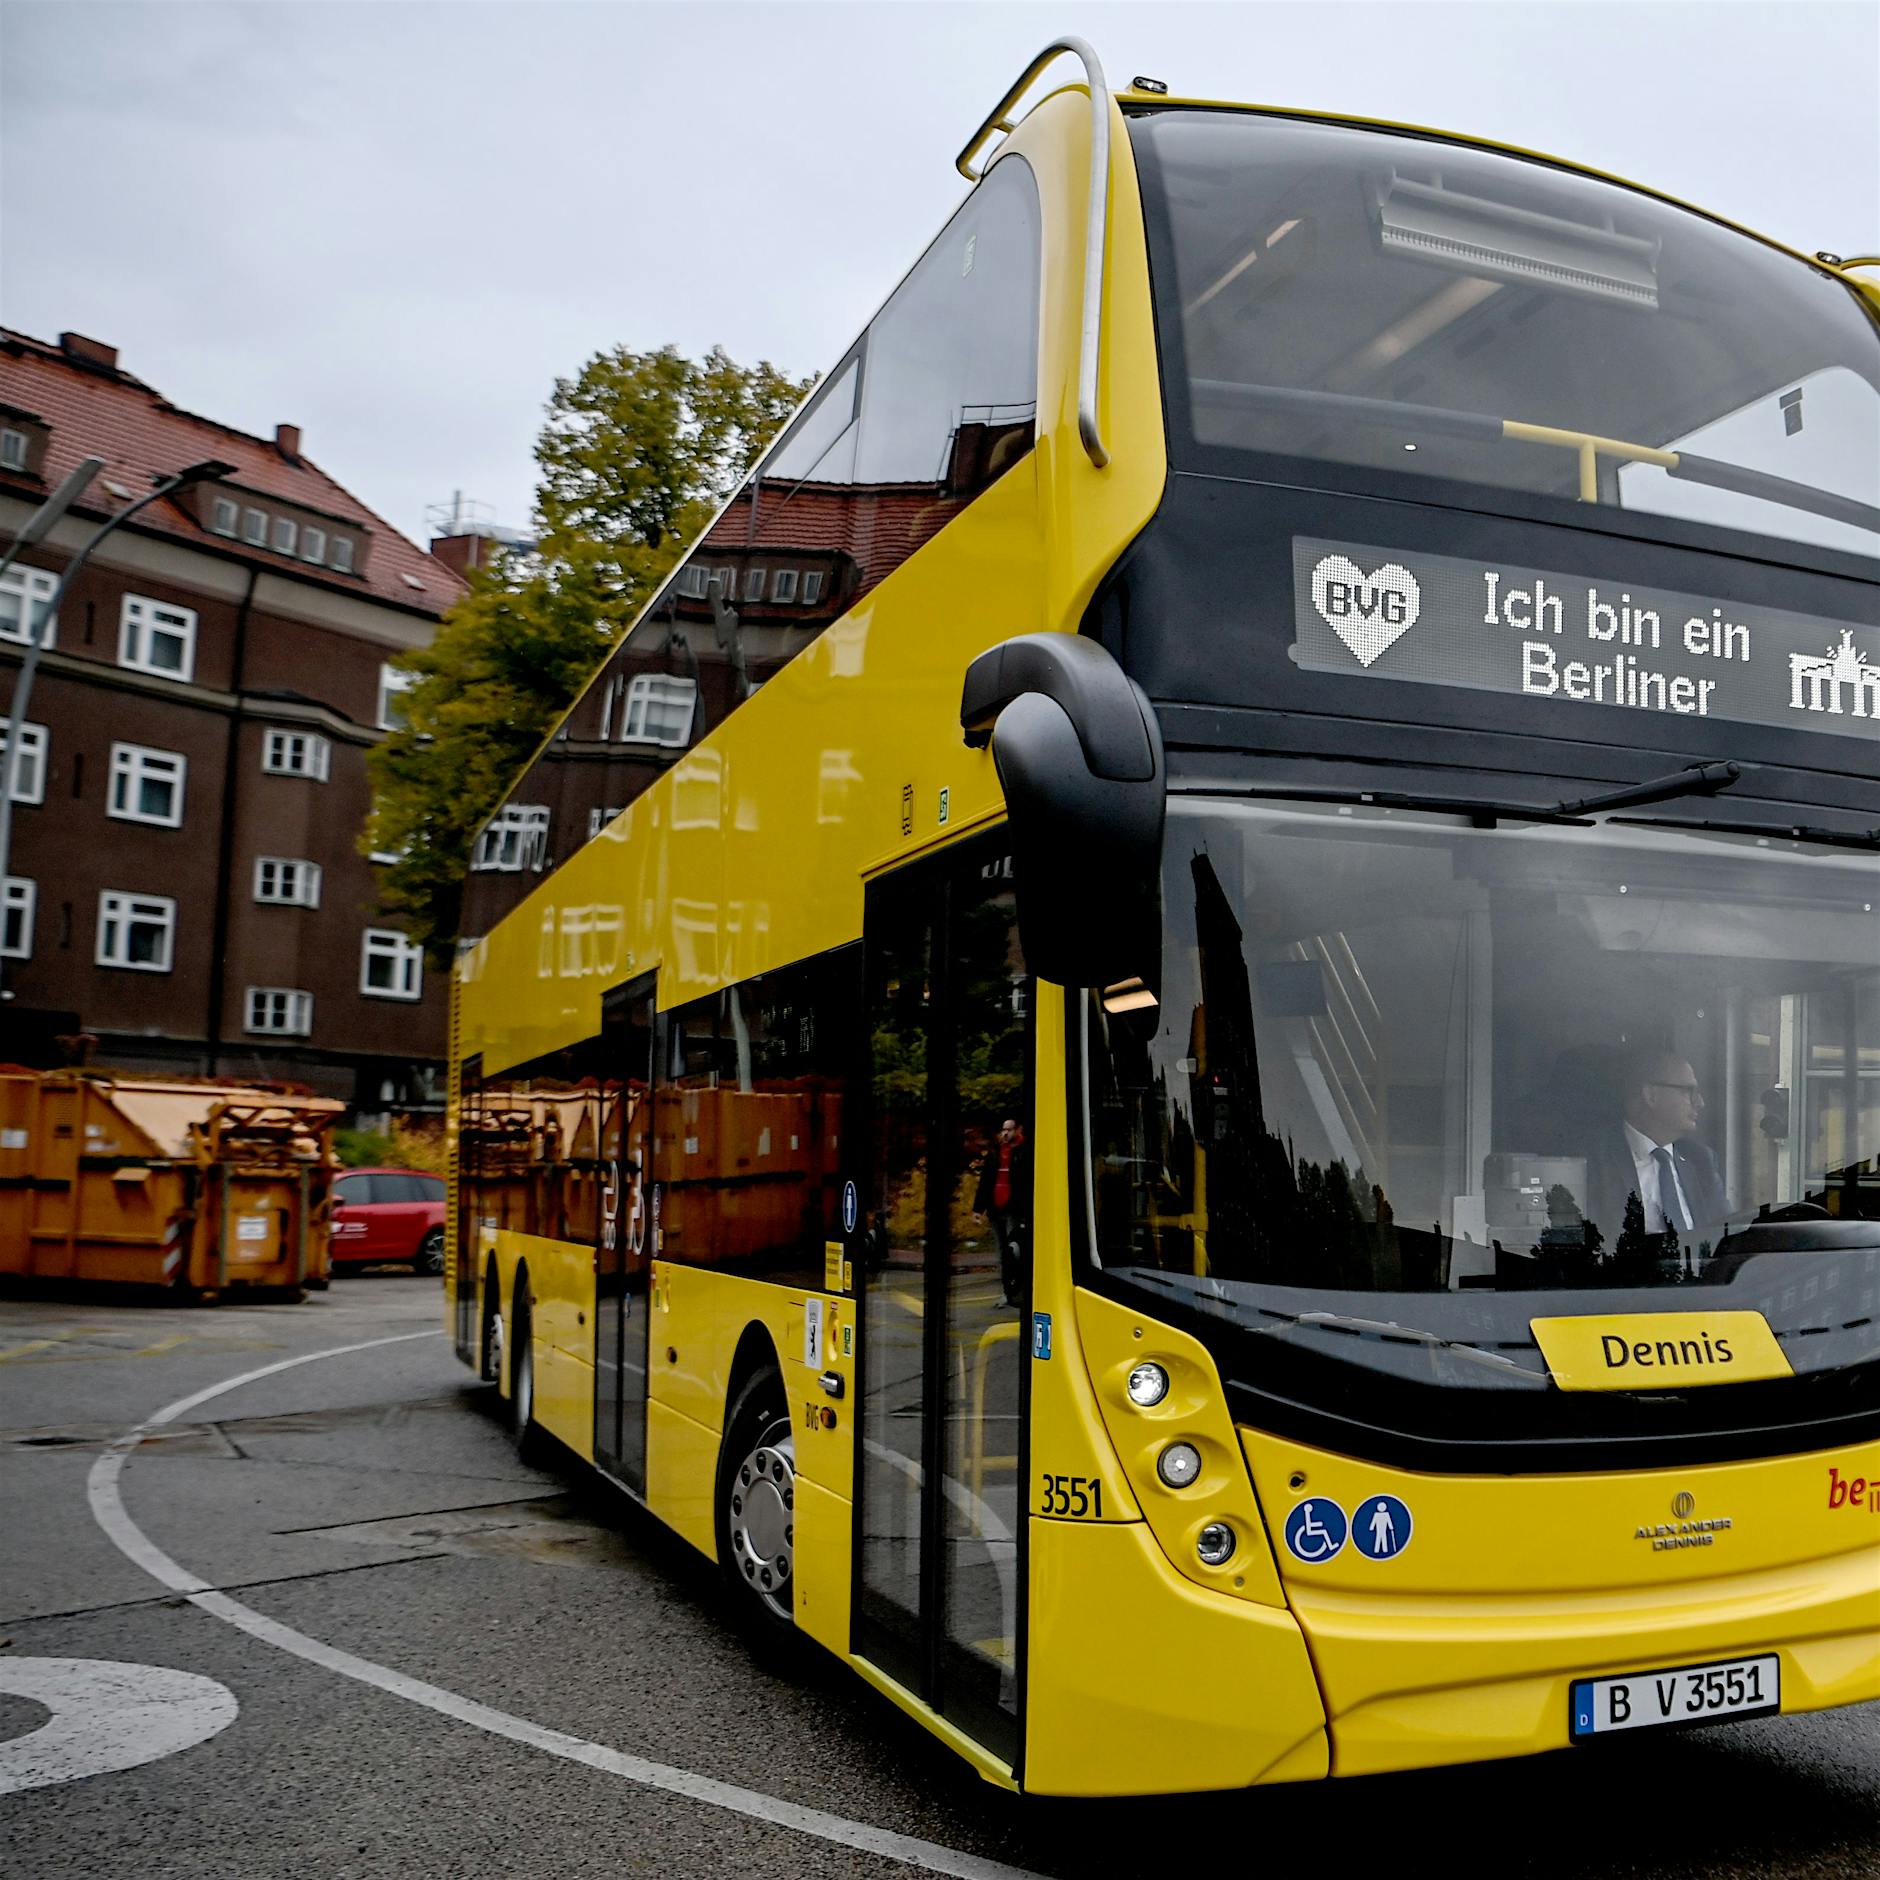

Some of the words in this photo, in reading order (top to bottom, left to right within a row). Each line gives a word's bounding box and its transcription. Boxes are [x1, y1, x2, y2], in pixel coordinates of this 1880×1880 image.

[1326, 580, 1407, 623] BVG
[1484, 571, 1563, 634] Ich
[1588, 587, 1660, 649] bin
[1683, 607, 1750, 662] ein
[1522, 640, 1716, 715] Berliner
[1600, 1331, 1734, 1368] Dennis
[1041, 1473, 1102, 1518] 3551
[1633, 1518, 1732, 1540] ALEXANDER
[1652, 1534, 1713, 1551] DENNIS
[1579, 1714, 1589, 1727] D
[1609, 1684, 1632, 1724] B
[1656, 1677, 1677, 1717] V
[1686, 1665, 1765, 1713] 3551
